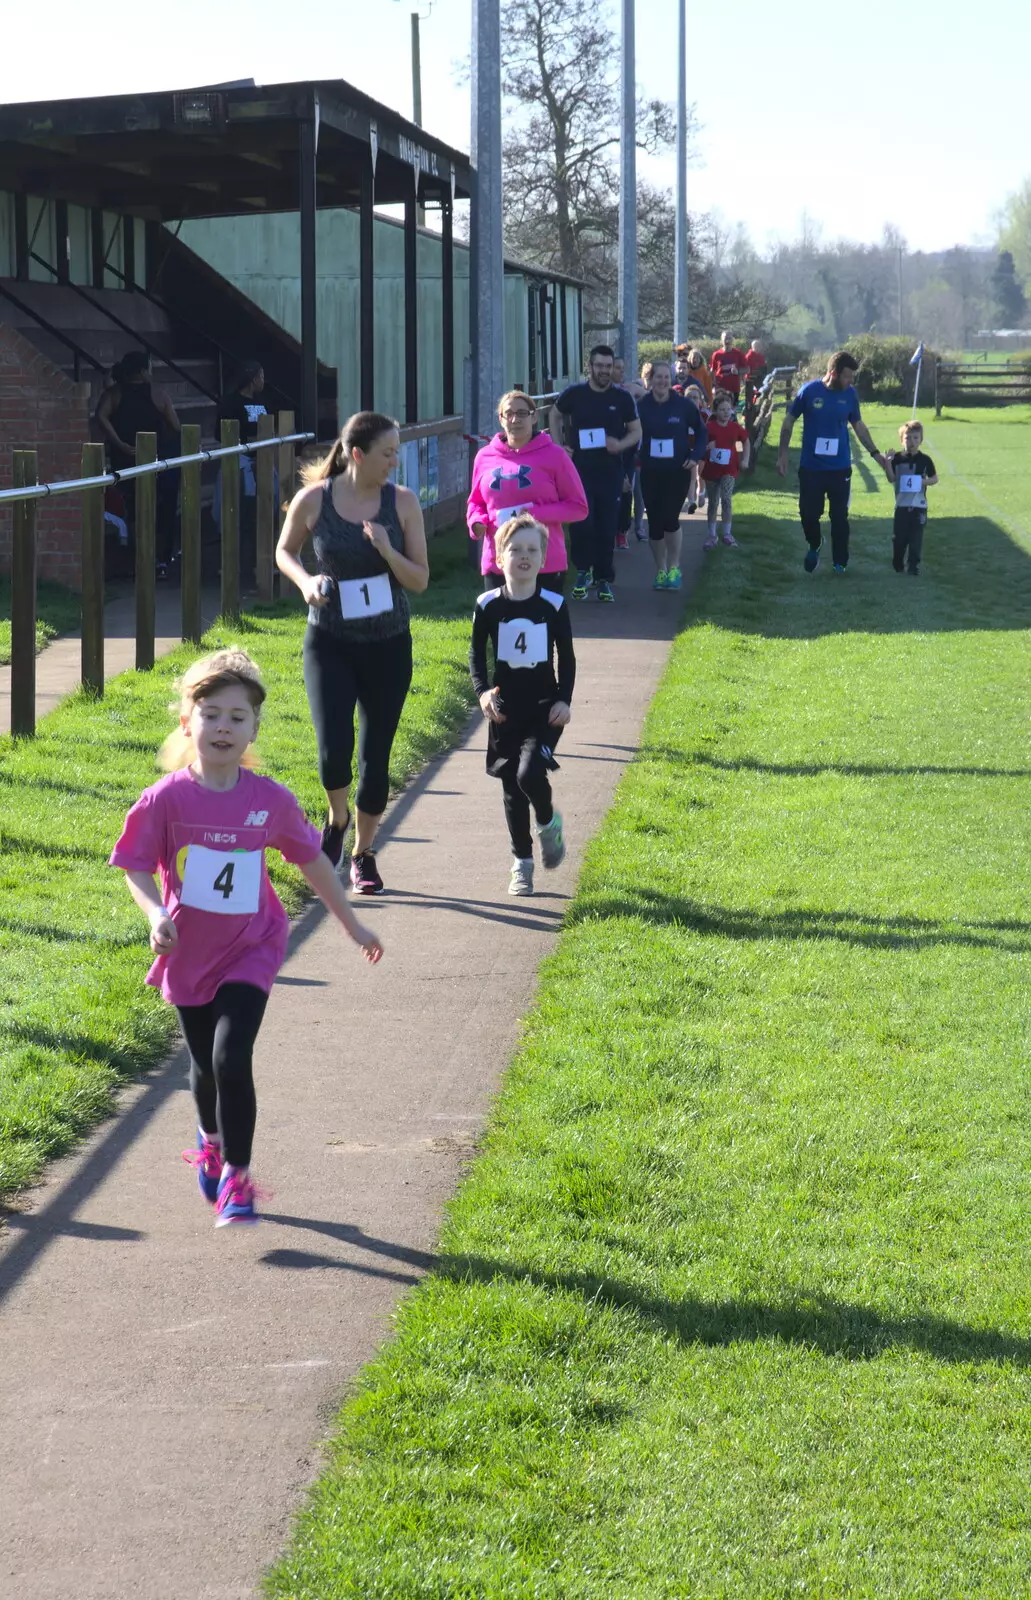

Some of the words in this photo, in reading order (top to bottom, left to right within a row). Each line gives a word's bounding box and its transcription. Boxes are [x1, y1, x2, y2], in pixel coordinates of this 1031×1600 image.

[824, 440, 830, 451] 1
[715, 450, 722, 461] 4
[906, 477, 913, 489] 4
[359, 582, 370, 606] 1
[514, 631, 527, 654] 4
[204, 832, 237, 843] INEOS
[213, 862, 235, 899] 4
